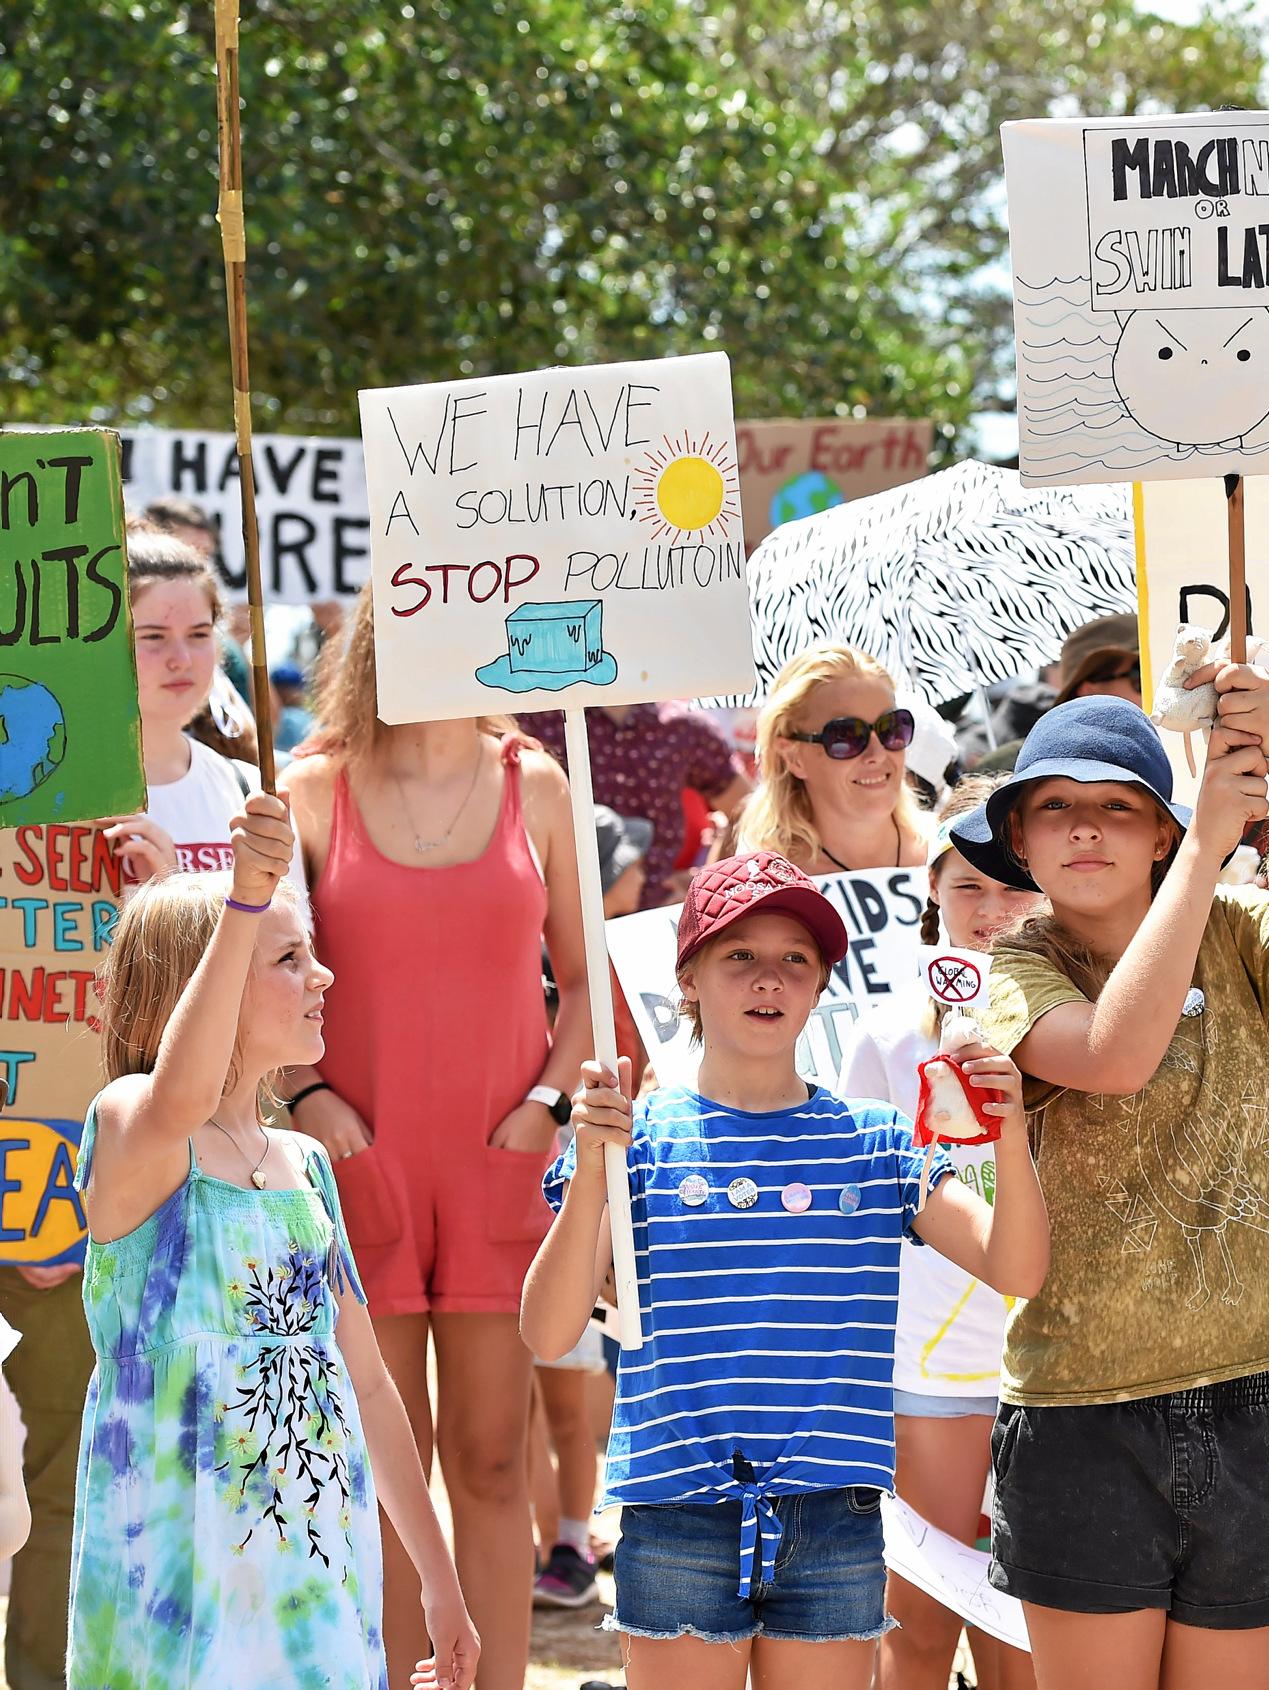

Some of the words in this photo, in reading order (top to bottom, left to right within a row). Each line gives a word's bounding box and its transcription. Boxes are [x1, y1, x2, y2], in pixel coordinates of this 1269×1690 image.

[1111, 137, 1241, 201] MARCH
[1195, 199, 1230, 219] OR
[1095, 227, 1192, 295] SWIM
[387, 392, 488, 476] WE
[514, 384, 661, 461] HAVE
[810, 425, 925, 472] Earth
[171, 439, 343, 504] HAVE
[385, 491, 420, 536] A
[455, 475, 637, 529] SOLUTION,
[391, 554, 540, 617] STOP
[564, 542, 742, 592] POLLUTOIN
[13, 824, 122, 898] SEEN
[724, 880, 774, 899] NOOSA
[0, 896, 121, 952] TER
[821, 873, 924, 935] IDS
[935, 976, 977, 989] WAMING
